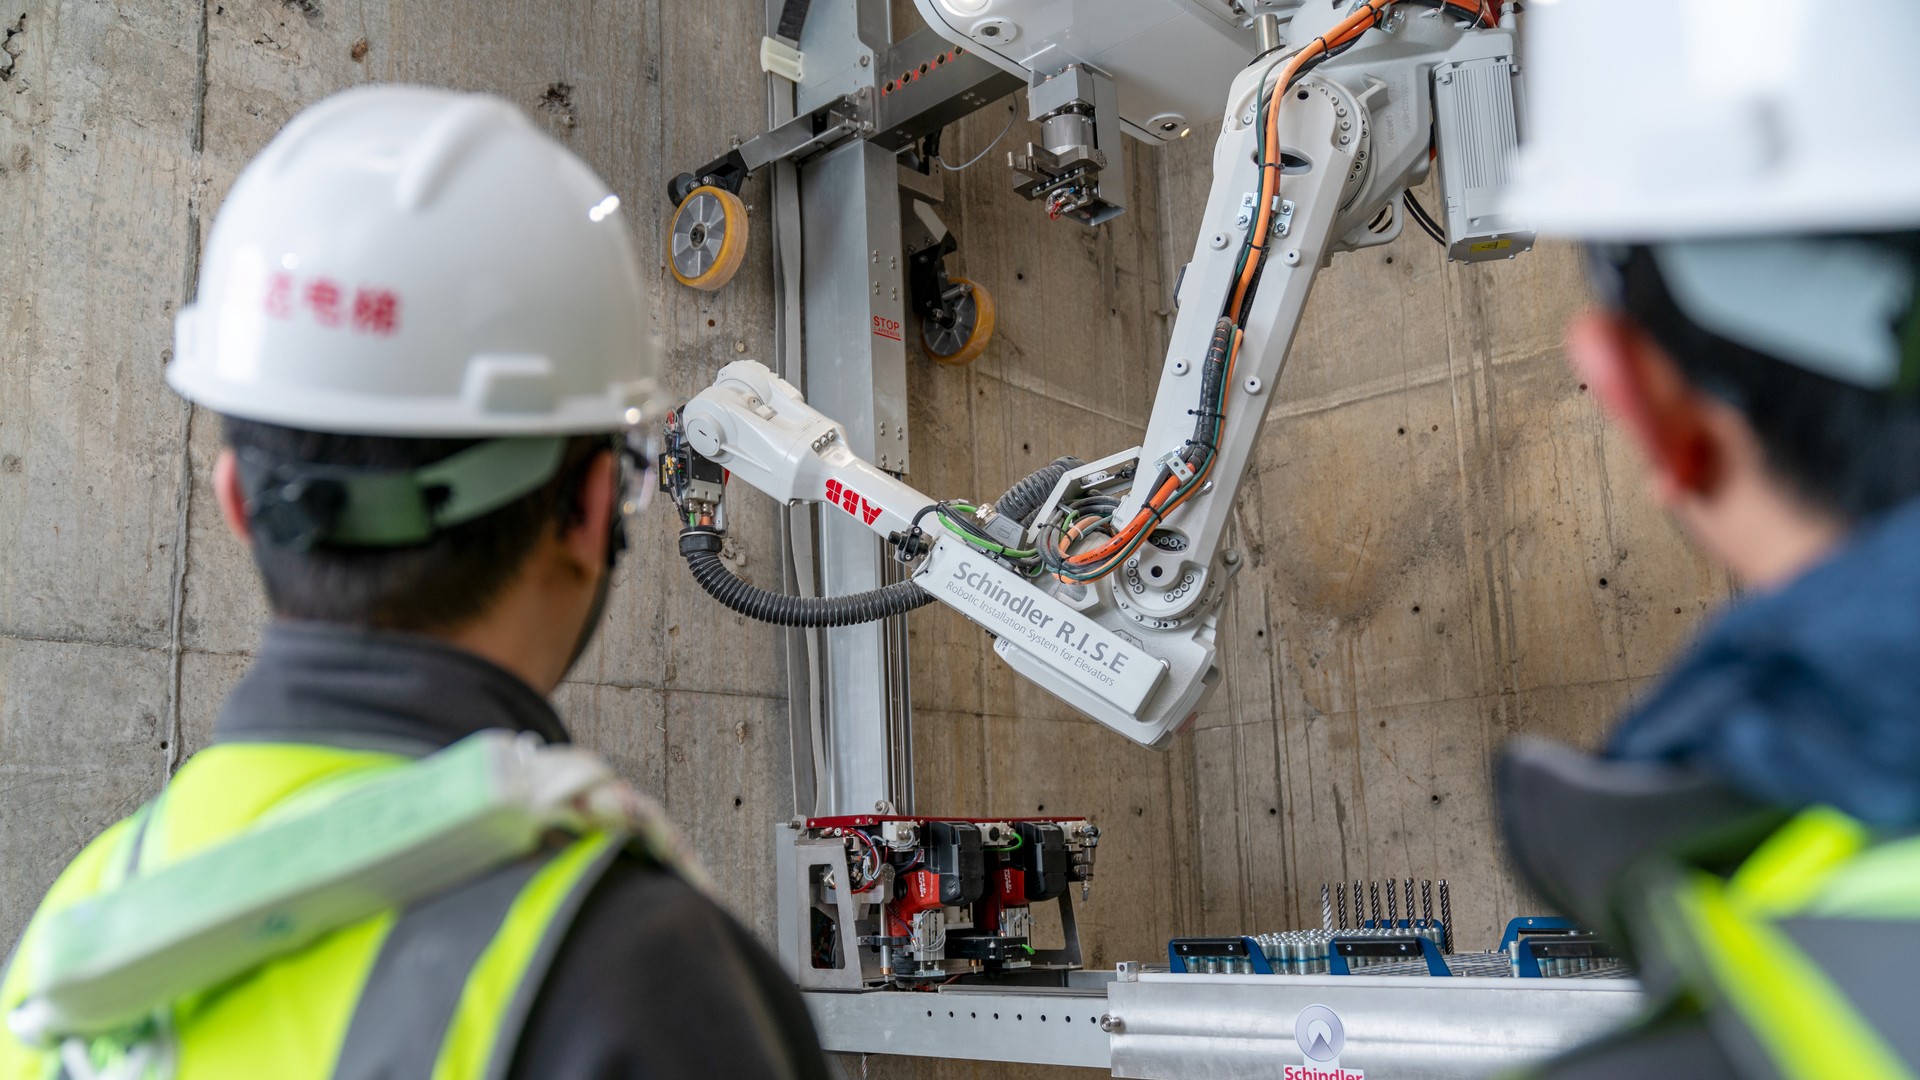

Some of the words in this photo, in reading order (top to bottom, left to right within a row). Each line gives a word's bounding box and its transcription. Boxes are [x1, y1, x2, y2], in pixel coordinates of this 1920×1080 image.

[873, 315, 900, 331] STOP
[825, 478, 883, 526] ABB
[945, 581, 978, 607] Robotic
[979, 601, 1027, 635] Installation
[1027, 629, 1059, 654] System
[1059, 647, 1075, 662] for
[1074, 656, 1115, 687] Elevators
[953, 561, 1053, 629] Schindler
[1055, 620, 1129, 674] R.I.S.E
[1284, 1066, 1363, 1080] Schindler
